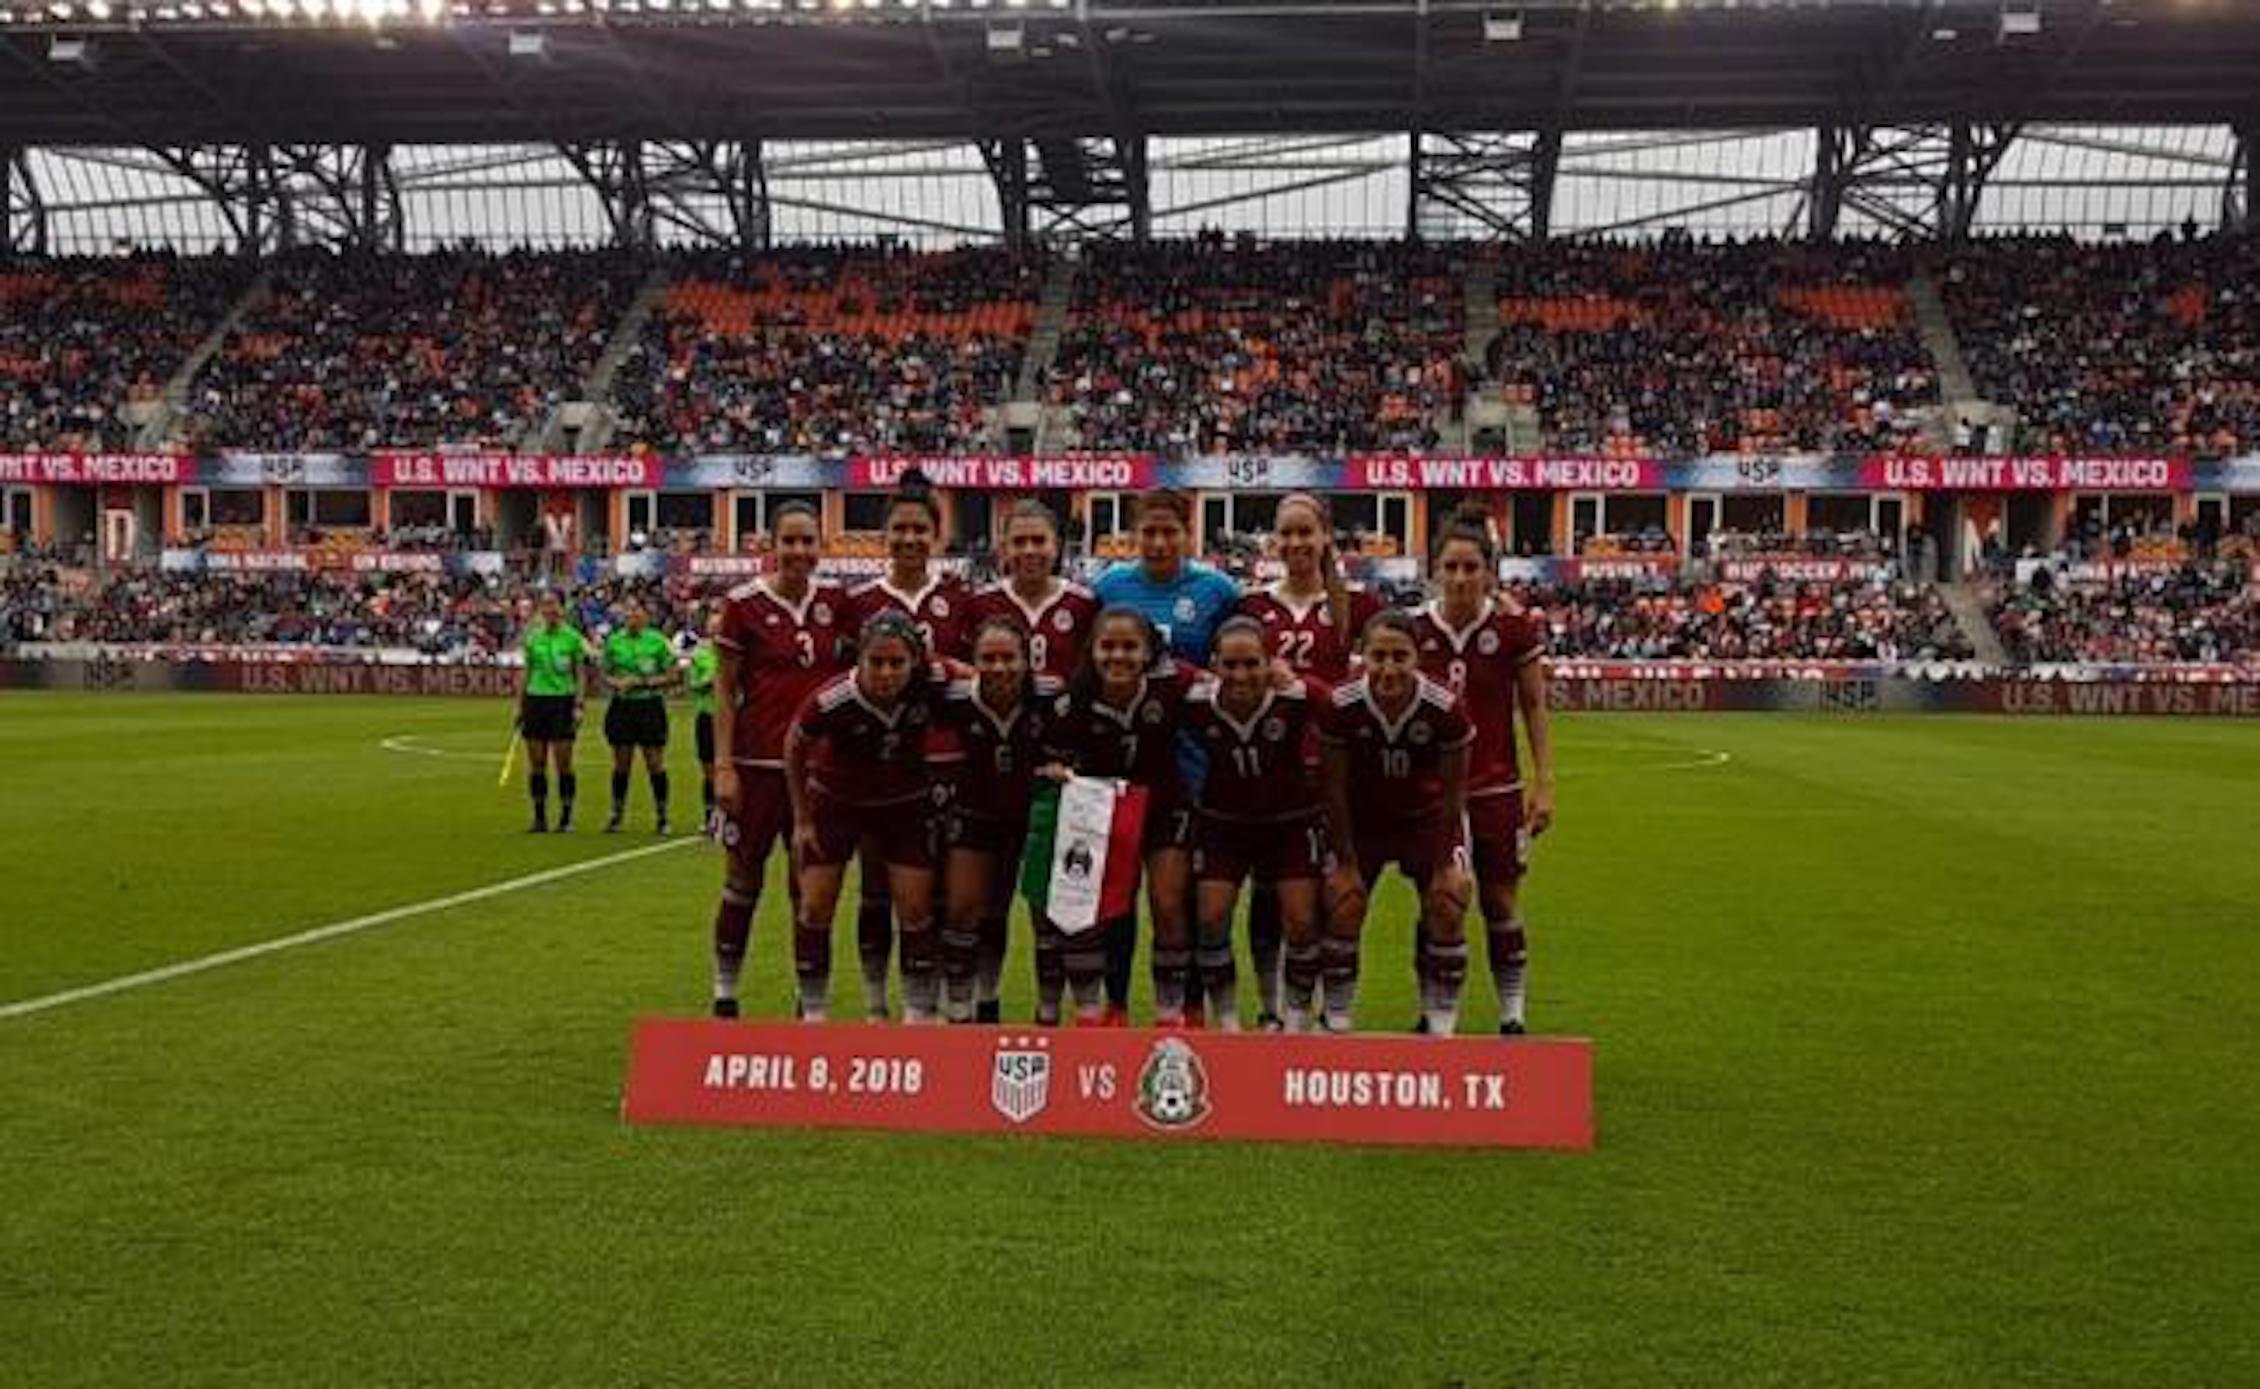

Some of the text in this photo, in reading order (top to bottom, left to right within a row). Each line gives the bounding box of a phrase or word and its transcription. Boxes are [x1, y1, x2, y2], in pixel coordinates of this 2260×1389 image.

[0, 456, 177, 482] NT VS. MEXICO
[394, 457, 645, 485] U.S. WNT VS. MEXICO
[869, 459, 1131, 487] U.S WNT VS. MEXICO
[1365, 459, 1640, 487] U.S. WNT VS. MEXICO
[1883, 459, 2168, 488] U.S. WNT VS. MEXICO
[795, 632, 815, 668] 3
[1277, 629, 1315, 669] 22
[299, 665, 364, 692] WNT
[421, 667, 517, 695] MEXIC
[1583, 680, 1706, 711] MEXICO
[2069, 683, 2143, 713] WNT
[1119, 734, 1139, 771] 7
[1231, 745, 1263, 779] 11
[1381, 747, 1411, 780] 10
[703, 1054, 924, 1095] APRIL 8, 2018
[1077, 1063, 1117, 1100] VS
[1284, 1067, 1505, 1111] HOUSTON, TX
